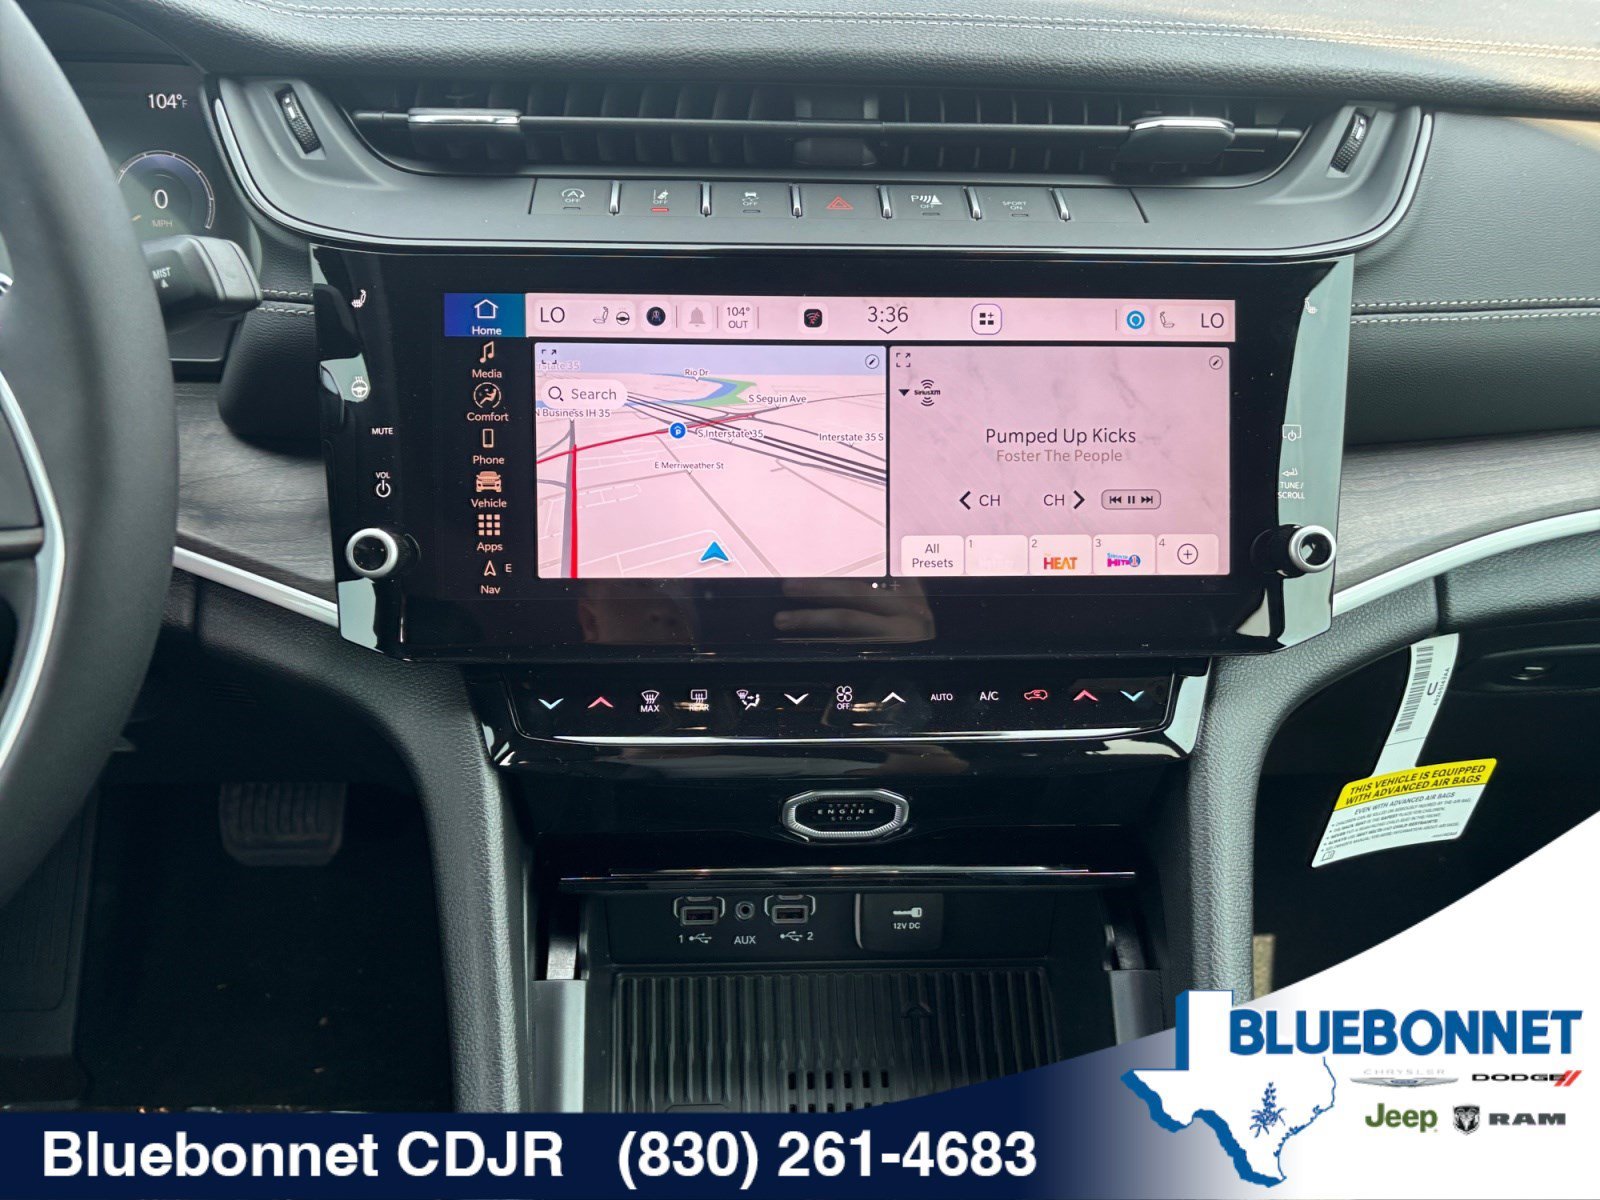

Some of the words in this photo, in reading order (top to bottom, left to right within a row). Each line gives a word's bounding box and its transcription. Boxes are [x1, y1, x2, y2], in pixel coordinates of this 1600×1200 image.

[154, 189, 169, 209] 0
[152, 219, 173, 228] MPH
[152, 267, 171, 279] MIST
[539, 306, 566, 324] LO
[726, 305, 751, 317] 104°
[867, 305, 909, 323] 3:36
[727, 319, 749, 330] OUT
[1200, 312, 1225, 329] LO
[471, 326, 502, 336] Home
[568, 361, 580, 370] 35
[471, 369, 503, 379] Media
[684, 368, 698, 376] Rio
[699, 368, 709, 376] Dr
[571, 388, 617, 400] Search
[748, 394, 754, 403] S
[756, 394, 788, 405] Seguin
[789, 394, 807, 403] Ave
[466, 411, 509, 422] Comfort
[542, 408, 584, 418] Business
[585, 409, 597, 417] IH
[598, 409, 611, 418] 35
[371, 427, 394, 435] MUTE
[697, 429, 704, 438] S
[705, 429, 750, 438] Interstate
[751, 429, 764, 438] 35
[818, 432, 863, 442] Interstate
[864, 433, 877, 442] 35
[878, 433, 884, 442] S
[985, 428, 1058, 446] Pumped
[1062, 428, 1088, 446] Up
[1092, 428, 1137, 445] Kicks
[472, 454, 505, 465] Phone
[996, 450, 1041, 463] Foster
[1043, 450, 1071, 462] The
[1074, 450, 1123, 464] People
[654, 461, 660, 470] E
[661, 461, 715, 470] Merriweather
[716, 461, 724, 470] St
[1280, 481, 1304, 489] TUNE/
[1278, 491, 1305, 499] SCROLL
[470, 498, 508, 509] Vehicle
[978, 494, 1001, 507] CH
[1043, 494, 1065, 507] CH
[476, 541, 504, 553] Apps
[969, 539, 974, 548] 1
[1031, 539, 1038, 548] 2
[1094, 538, 1102, 548] 3
[1158, 538, 1166, 548] 4
[924, 543, 940, 554] All
[505, 563, 513, 573] E
[911, 558, 954, 569] Presets
[1043, 557, 1078, 570] HEAT
[480, 584, 501, 594] Nav
[930, 693, 953, 701] AUTO
[979, 691, 999, 701] A/C
[640, 704, 660, 713] MAX
[689, 703, 710, 712] REAR
[836, 702, 850, 710] OFF
[1350, 782, 1373, 796] THIS
[1375, 773, 1418, 789] VEHICLE
[1419, 771, 1431, 781] IS
[1431, 764, 1486, 778] EQUIPPED
[1345, 791, 1372, 806] WITH
[1372, 780, 1430, 798] ADVANCED
[1431, 777, 1451, 787] AIR
[1452, 774, 1482, 785] BAGS
[1372, 801, 1389, 811] WITH
[1388, 795, 1425, 807] ADVANCED
[1425, 793, 1437, 801] AIR
[1437, 791, 1456, 799] BAGS
[893, 922, 907, 930] 12V
[908, 922, 921, 930] DC
[678, 934, 684, 944] 1
[733, 935, 757, 945] AUX
[807, 931, 814, 941] 2
